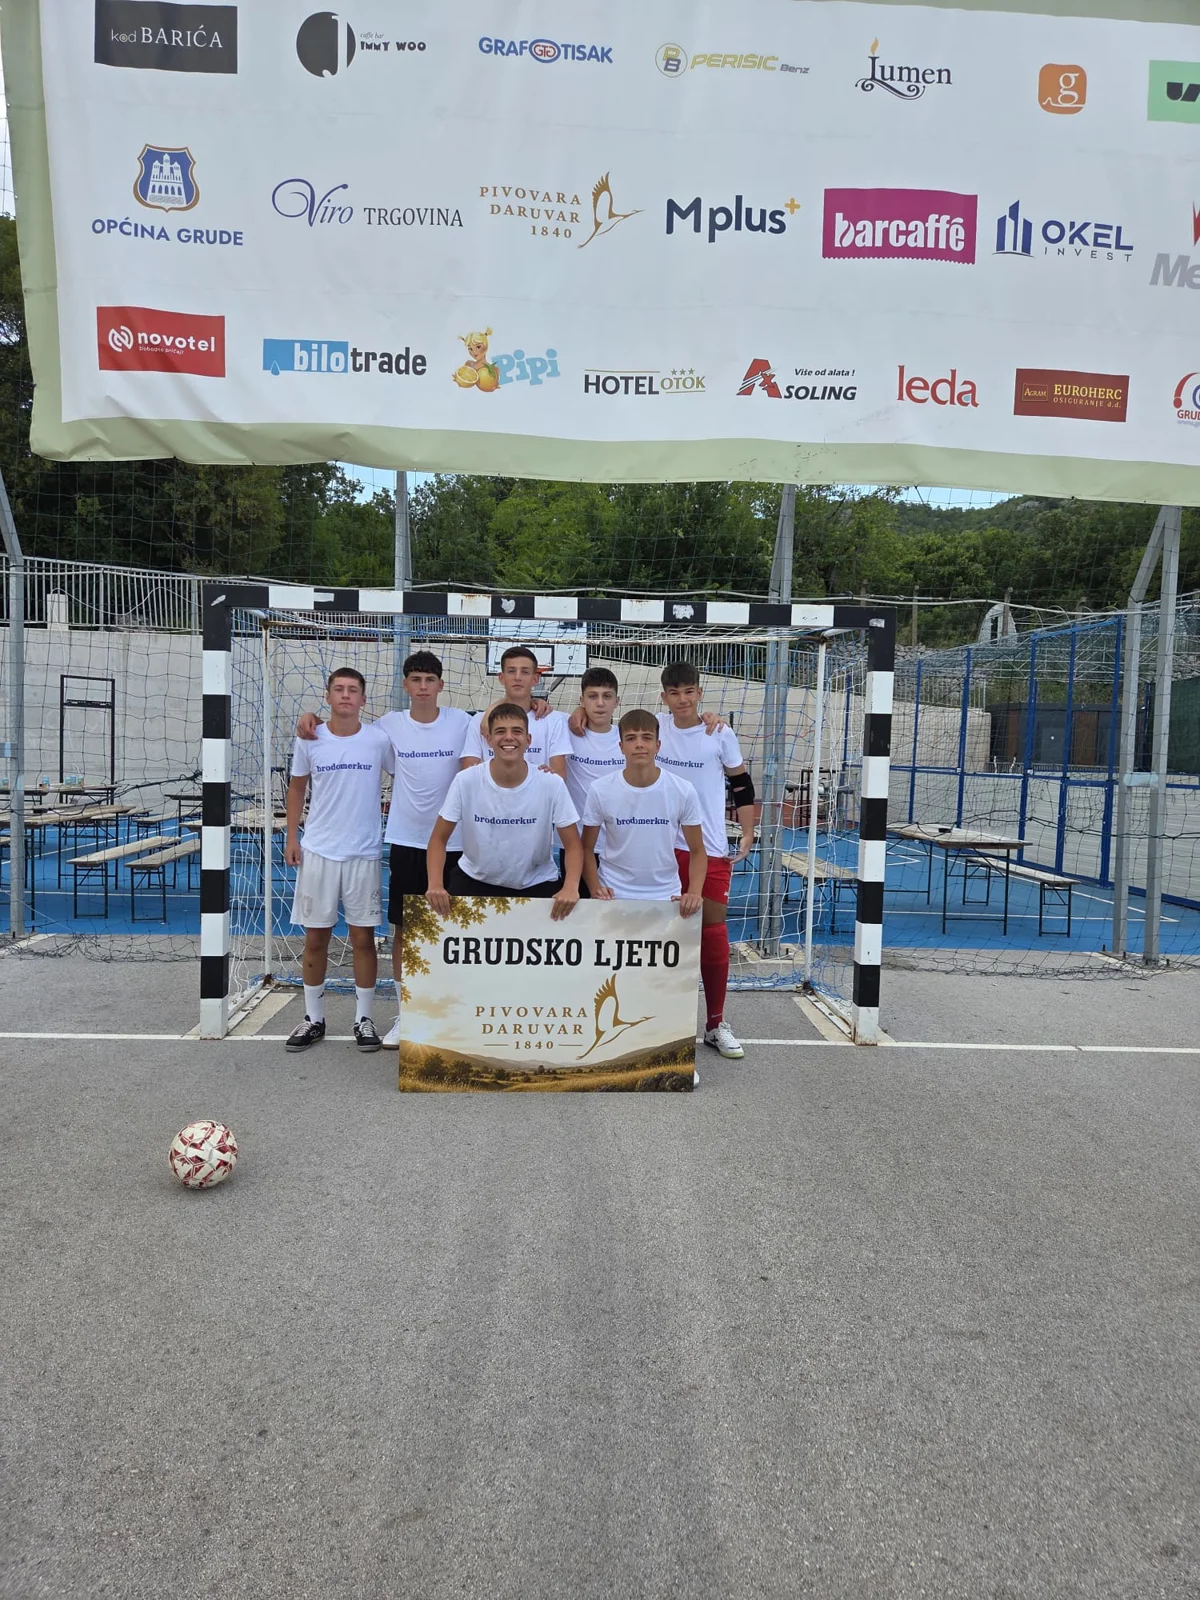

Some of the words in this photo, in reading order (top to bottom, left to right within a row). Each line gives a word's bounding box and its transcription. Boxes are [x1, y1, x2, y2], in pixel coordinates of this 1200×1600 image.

[141, 24, 223, 48] BARIĆA
[396, 41, 427, 51] WOO
[780, 64, 810, 74] Benz
[855, 56, 953, 100] Lumen
[272, 178, 354, 227] Viro
[363, 207, 464, 227] TRGOVINA
[479, 186, 582, 205] PIVOVARA
[490, 204, 580, 223] DARUVAR
[91, 217, 170, 241] OPĆINA
[177, 228, 243, 246] GRUDE
[531, 225, 572, 238] 1840
[834, 212, 965, 252] barcaffé
[1041, 220, 1134, 251] OKEL
[1044, 247, 1132, 262] INVEST
[138, 332, 215, 352] novotel
[492, 349, 561, 386] Pipi
[795, 368, 813, 377] Više
[815, 368, 827, 377] od
[828, 369, 850, 377] alata
[584, 374, 659, 395] HOTEL
[660, 376, 706, 390] OTOK
[897, 365, 980, 408] leda
[1054, 384, 1122, 400] EUROHERC
[1053, 397, 1104, 408] OSIGURANJE
[397, 750, 455, 759] brodomerkur
[316, 762, 373, 773] brodomerkur
[474, 814, 538, 826] brodomerkur
[616, 816, 670, 826] brodomerkur
[443, 937, 583, 966] GRUDSKO
[594, 939, 680, 971] LJETO
[475, 1006, 588, 1018] PIVOVARA
[481, 1023, 584, 1035] DARUVAR
[514, 1041, 554, 1050] 1840
